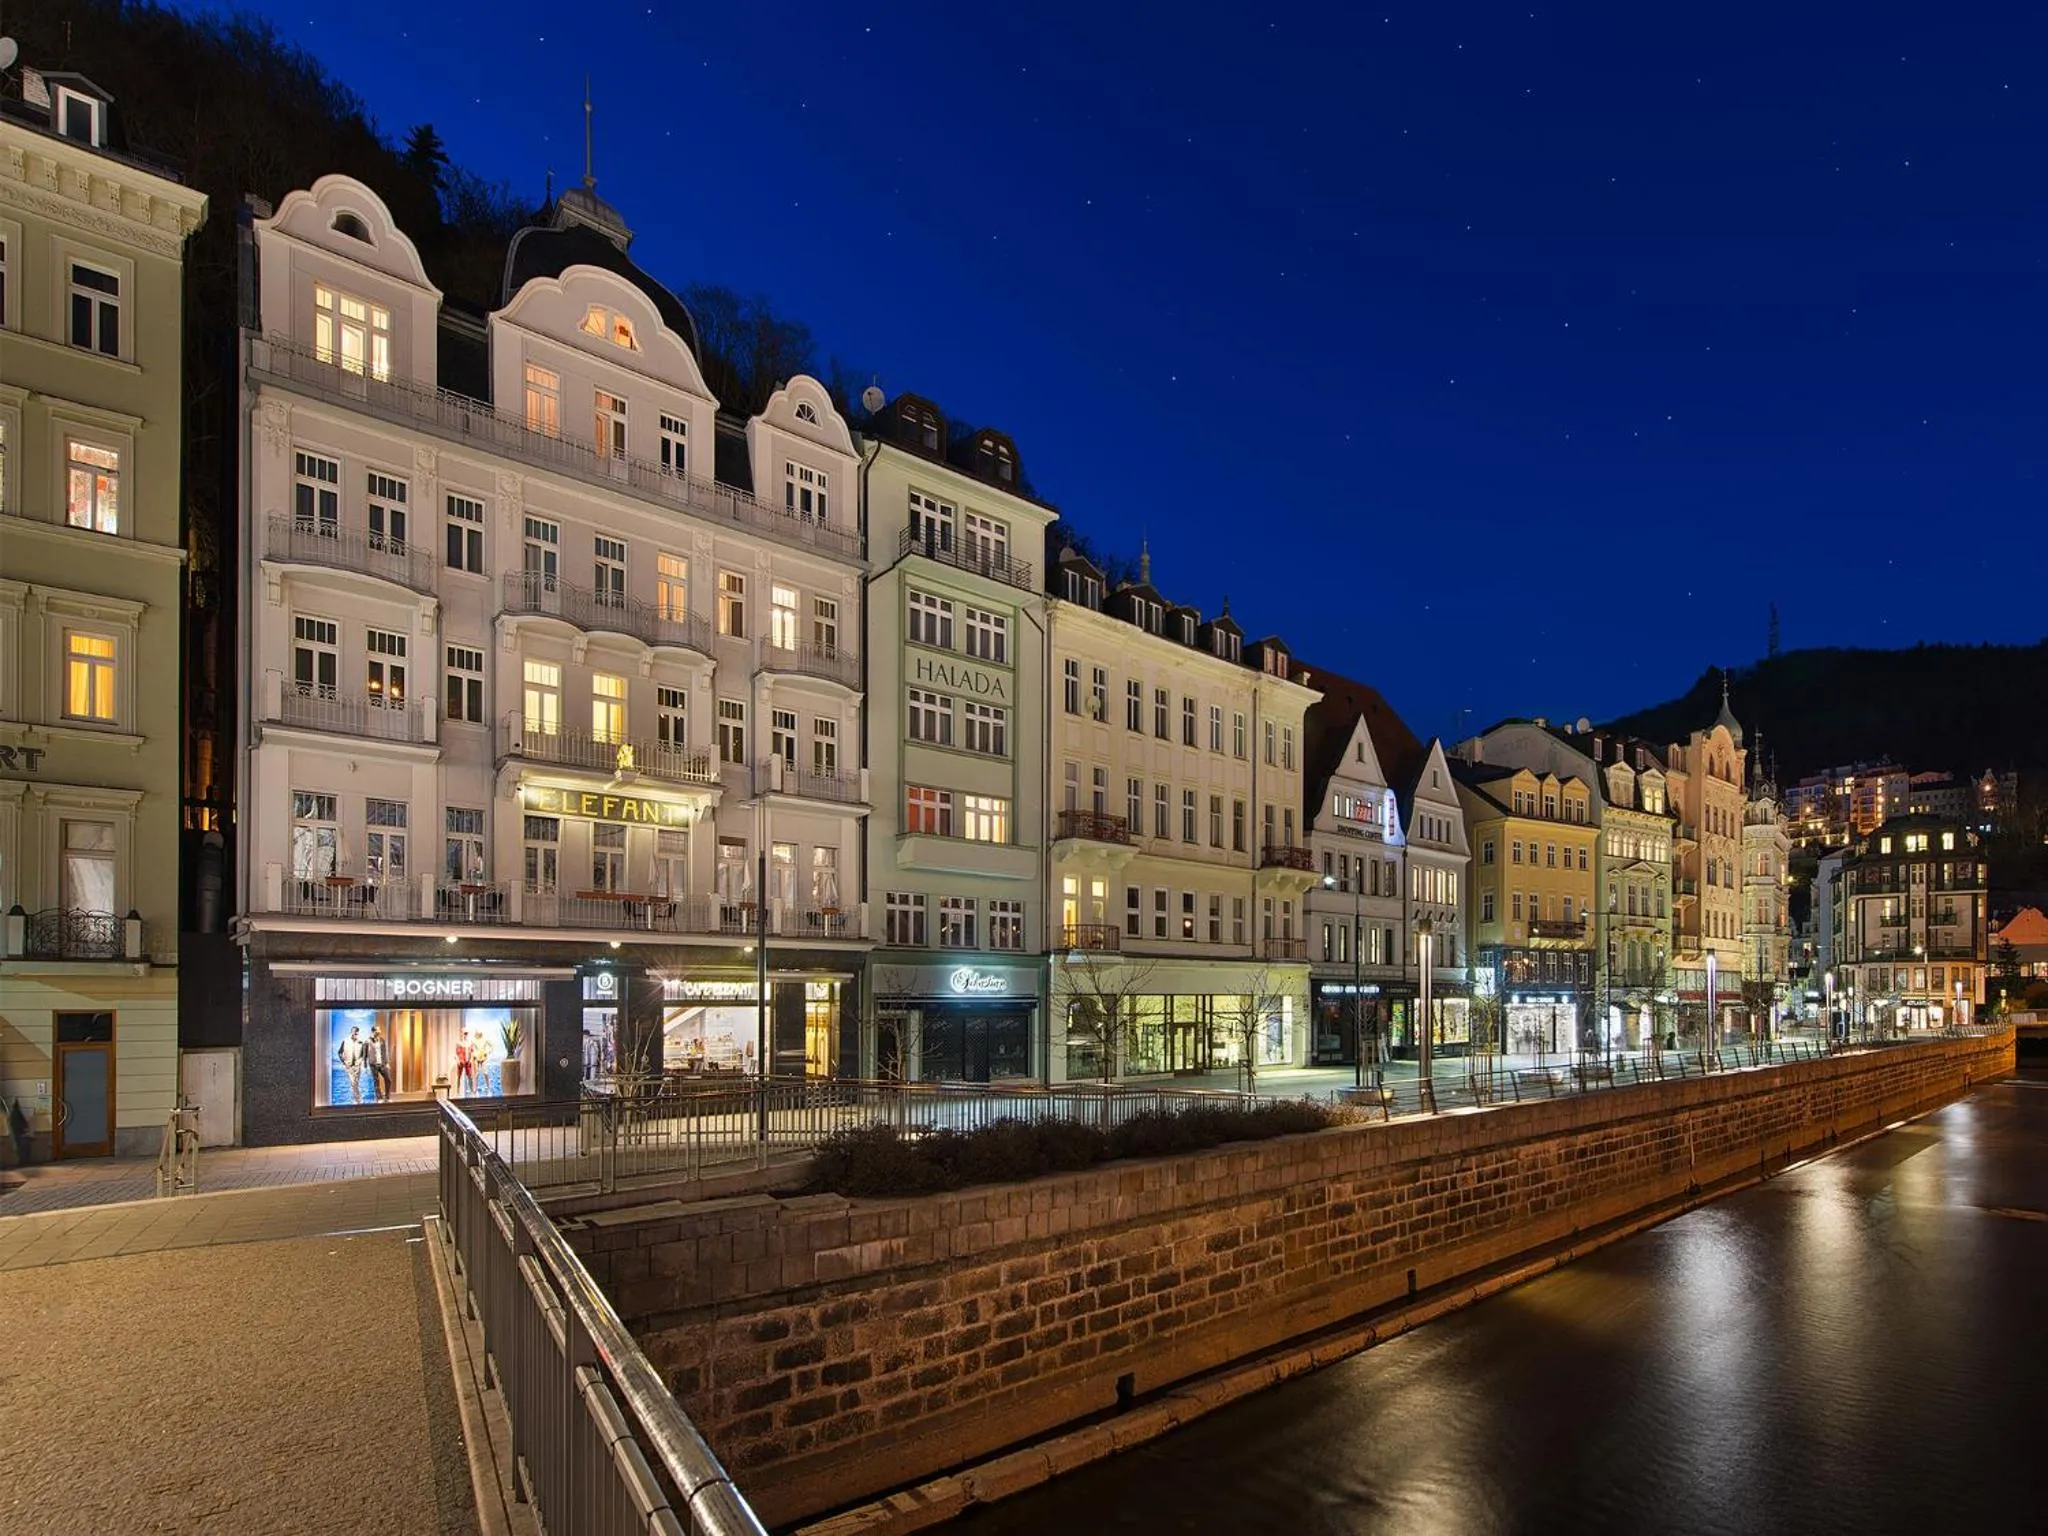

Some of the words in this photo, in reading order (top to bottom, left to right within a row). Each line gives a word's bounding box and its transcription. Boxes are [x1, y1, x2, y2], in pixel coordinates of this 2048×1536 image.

[916, 657, 1005, 699] HALADA
[537, 787, 680, 825] ELEFANT
[393, 979, 474, 995] BOGNER
